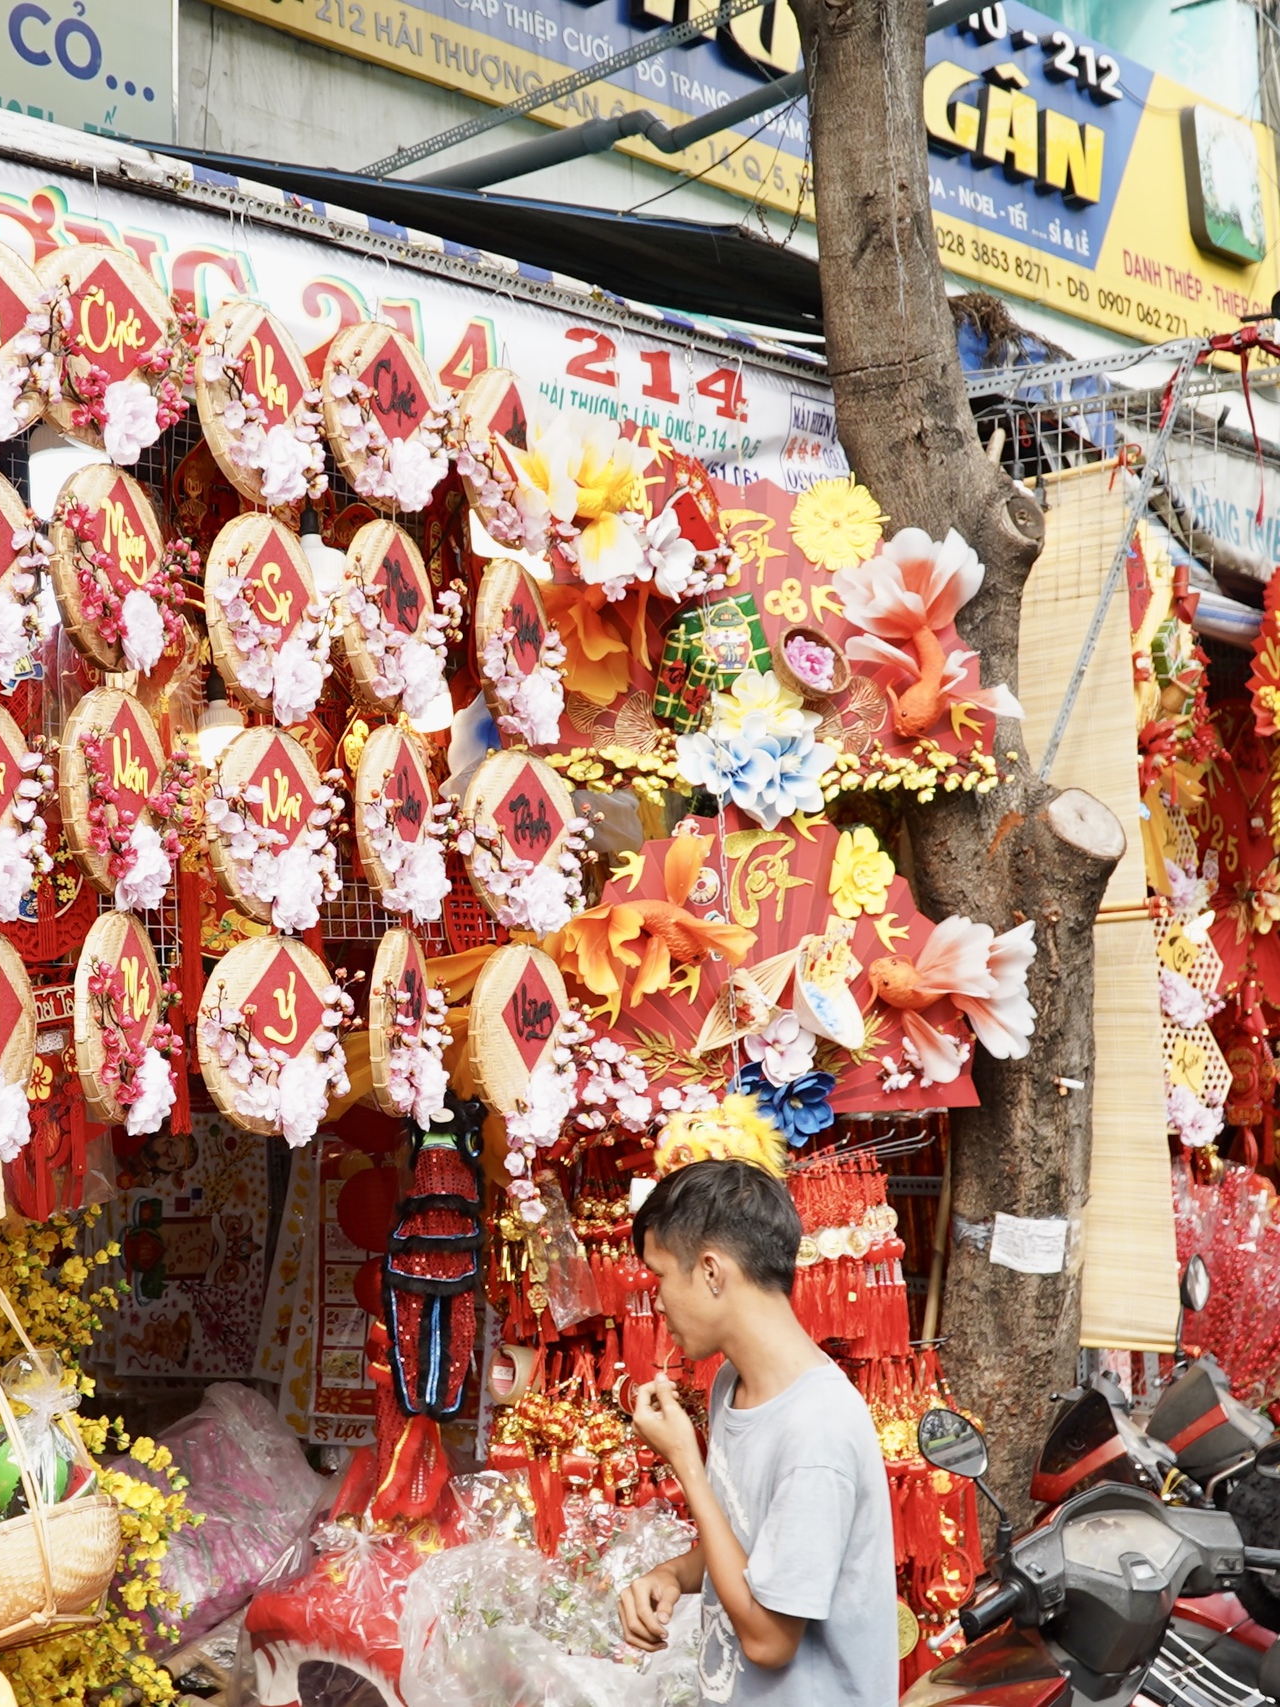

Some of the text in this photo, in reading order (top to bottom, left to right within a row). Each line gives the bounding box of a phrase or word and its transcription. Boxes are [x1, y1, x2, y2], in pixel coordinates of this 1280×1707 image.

[375, 10, 424, 57] HẢI
[430, 33, 543, 94] THƯỢNG
[503, 2, 557, 44] THIỆP
[671, 71, 732, 110] TRANG
[1052, 31, 1123, 99] 212
[923, 59, 1105, 204] GÂN
[958, 185, 997, 219] NOEL
[1007, 202, 1029, 231] TẾT
[935, 227, 966, 256] 028
[971, 239, 1010, 273] 3853
[1015, 256, 1051, 288] 8271
[1098, 288, 1132, 318] 0907
[1136, 302, 1163, 330] 062
[1165, 313, 1189, 338] 271
[1123, 249, 1162, 288] DANH
[80, 288, 146, 363] Chúc
[373, 358, 418, 428] Chúc
[564, 327, 748, 422] 214
[665, 409, 692, 443] ÔNG
[697, 426, 727, 452] P.14
[100, 497, 148, 586] Mừng
[112, 727, 149, 799] Năm
[261, 767, 302, 831] Như
[121, 956, 151, 1022] Mới
[263, 971, 298, 1045] Ý
